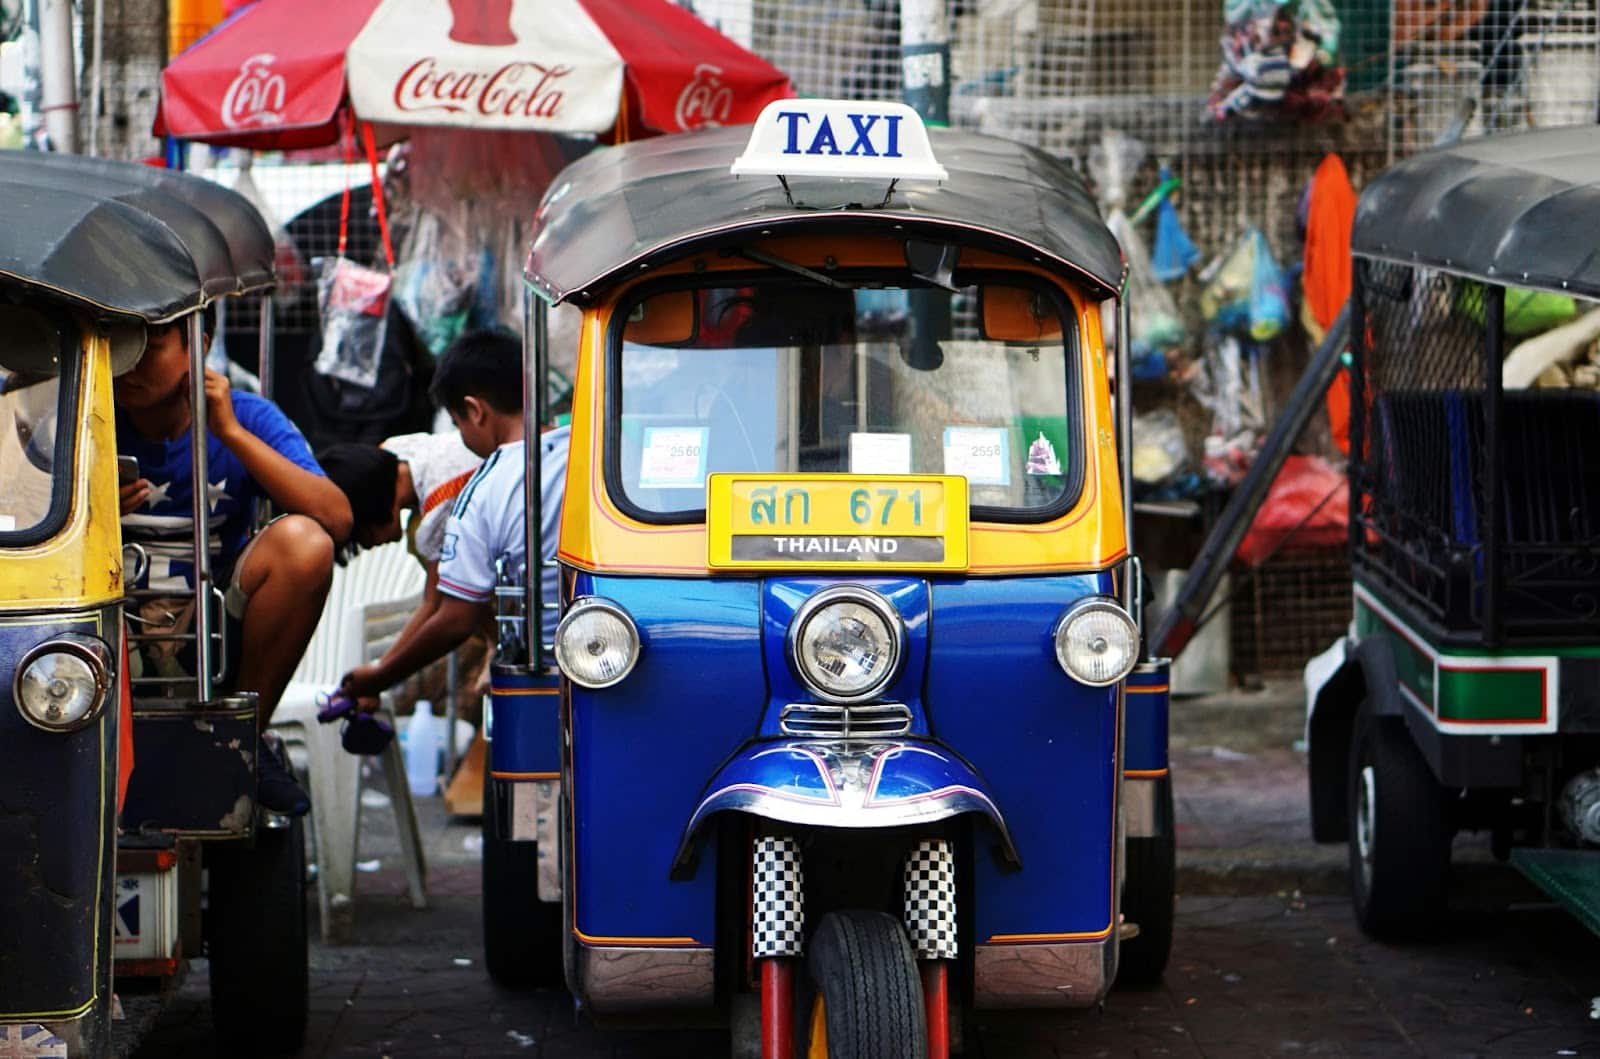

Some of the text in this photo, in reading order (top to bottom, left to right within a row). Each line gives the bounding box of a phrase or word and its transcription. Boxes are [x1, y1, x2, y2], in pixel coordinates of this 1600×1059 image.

[221, 53, 286, 128] โค้ก
[394, 57, 574, 117] Coca-Cola
[777, 112, 903, 158] TAXI
[670, 445, 700, 457] 2560
[750, 486, 922, 526] สก 671
[773, 537, 898, 554] THAILAND
